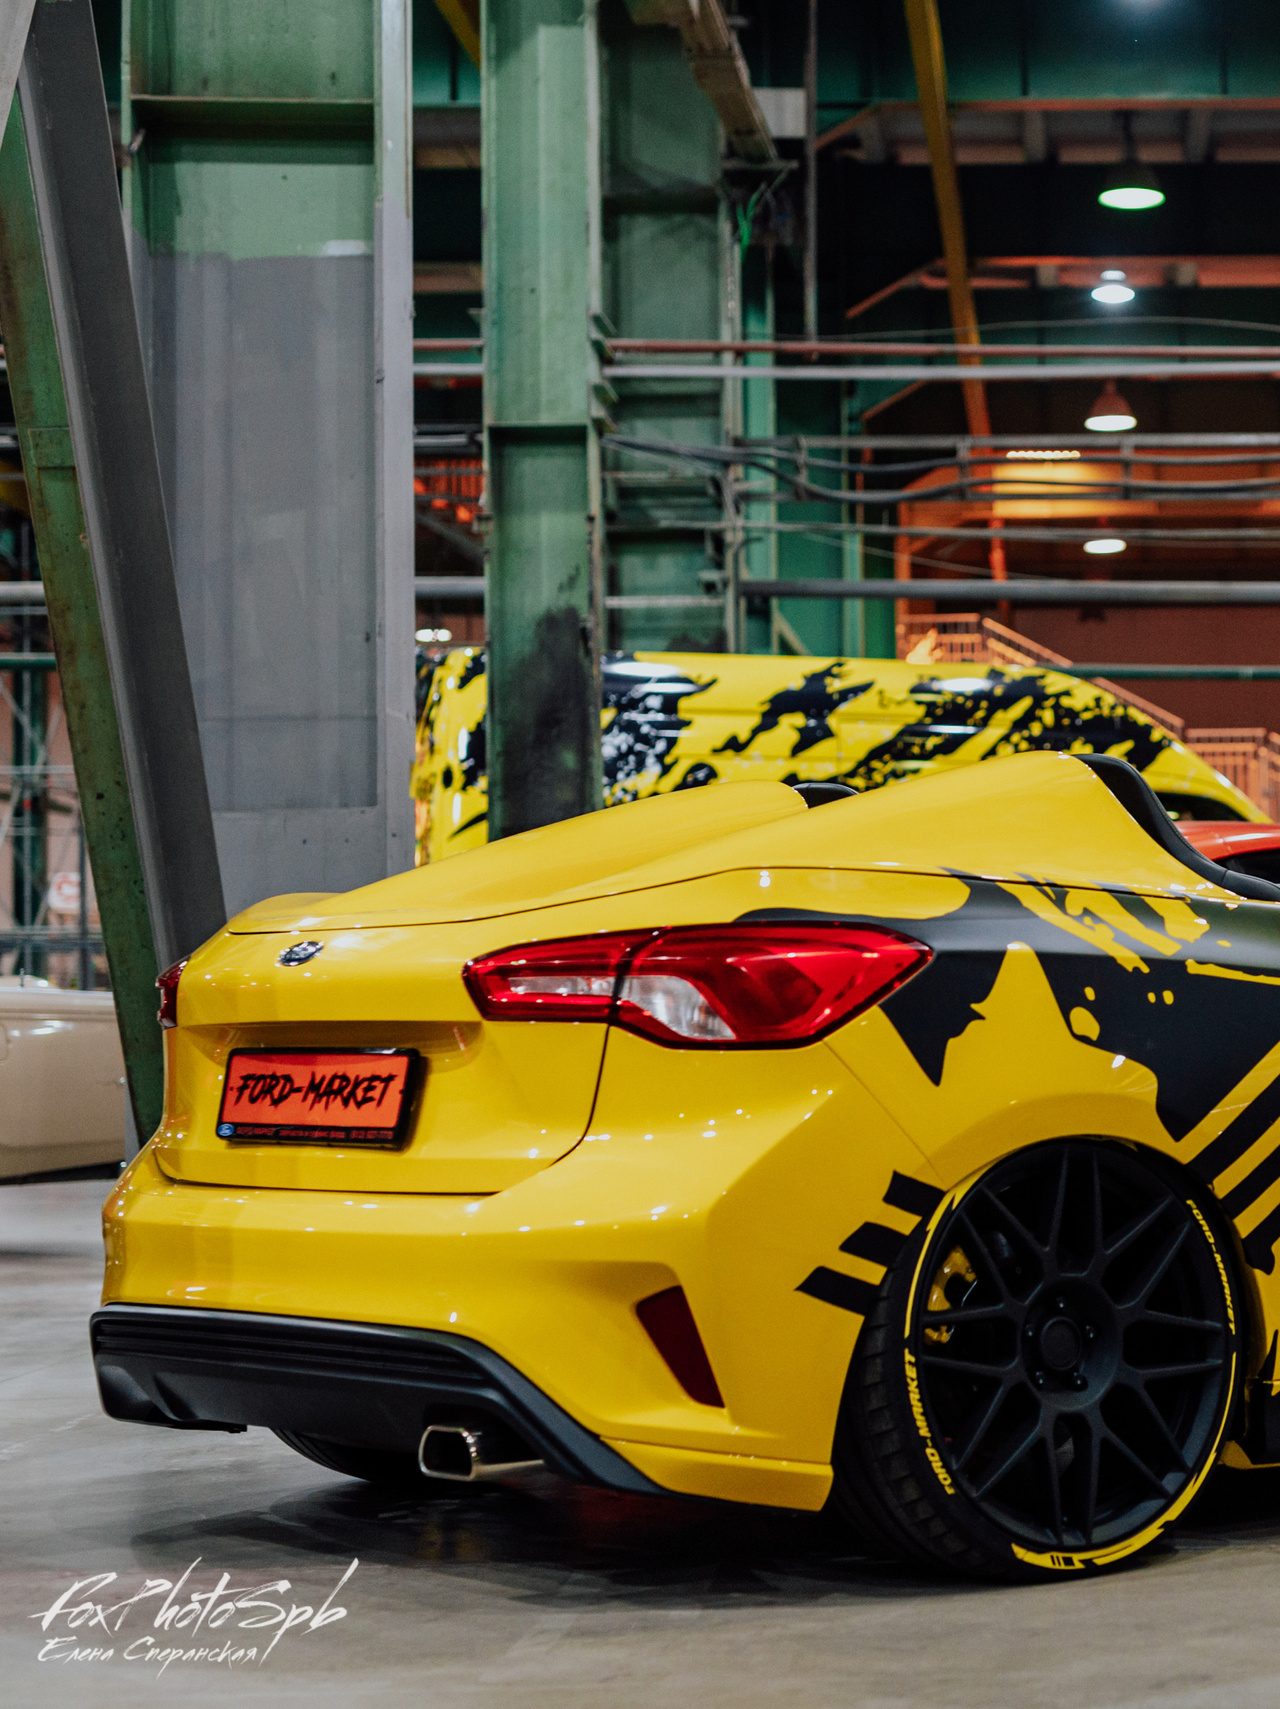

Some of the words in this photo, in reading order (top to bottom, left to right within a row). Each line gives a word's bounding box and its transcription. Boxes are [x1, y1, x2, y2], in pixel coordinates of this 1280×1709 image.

[234, 1071, 398, 1111] FORD-MARKET
[1186, 1199, 1236, 1336] FORD-MARKET
[904, 1347, 956, 1495] FORD-MARKET
